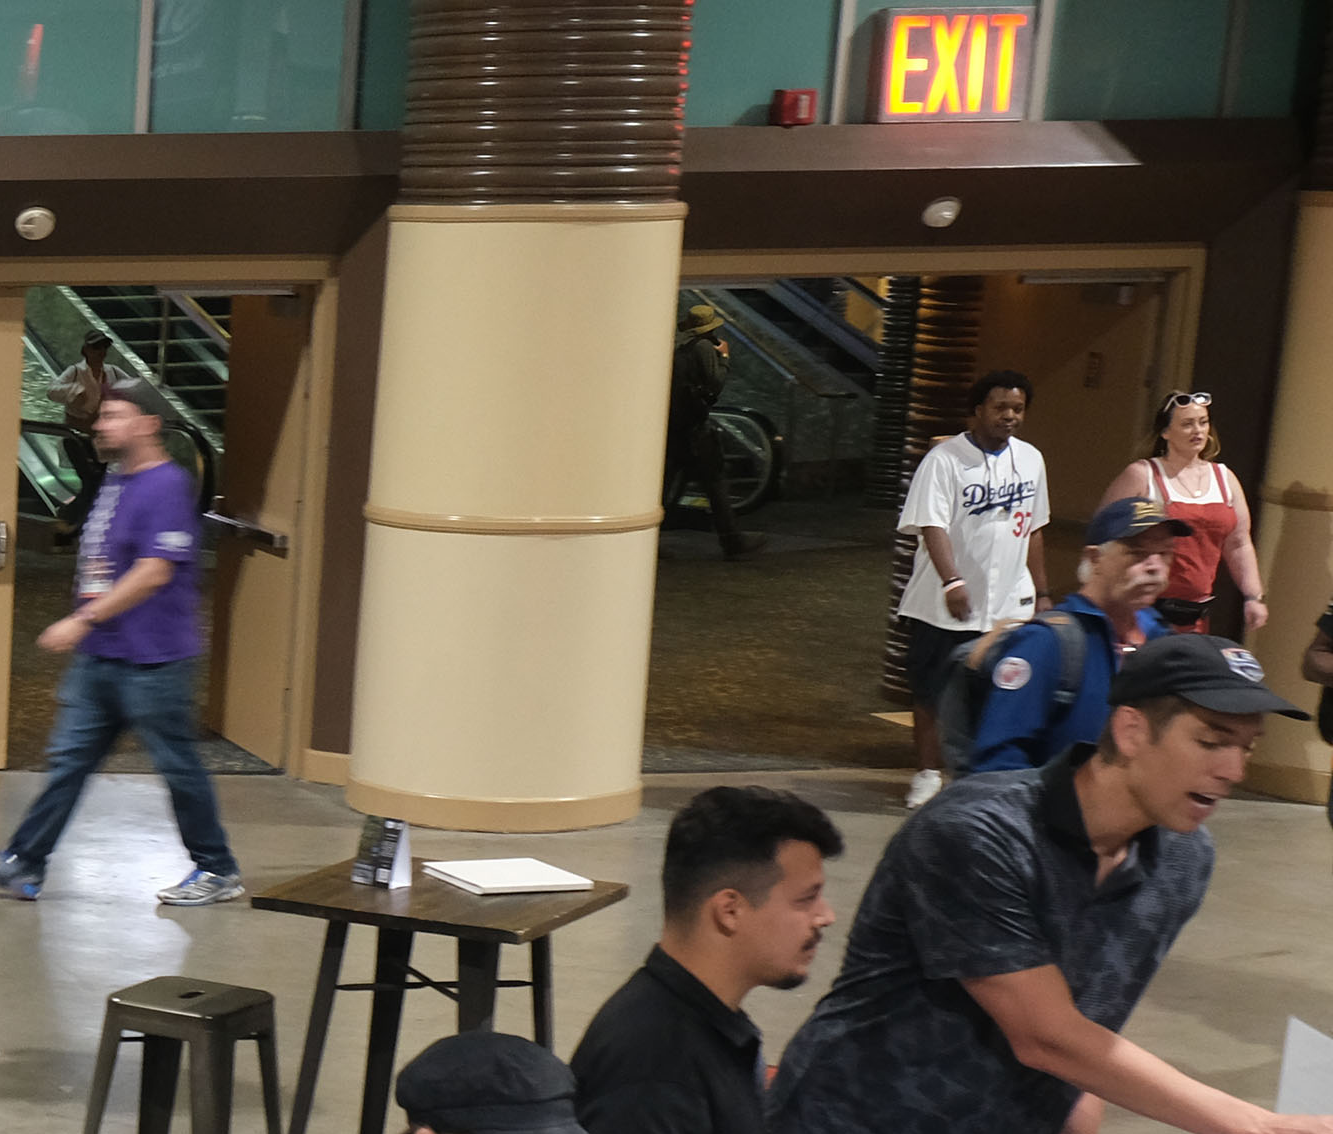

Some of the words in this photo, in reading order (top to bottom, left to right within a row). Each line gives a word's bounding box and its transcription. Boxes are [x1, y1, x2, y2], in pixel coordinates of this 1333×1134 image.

[886, 14, 1028, 115] EXIT
[962, 479, 1035, 515] Dodgers
[1013, 511, 1033, 538] 37
